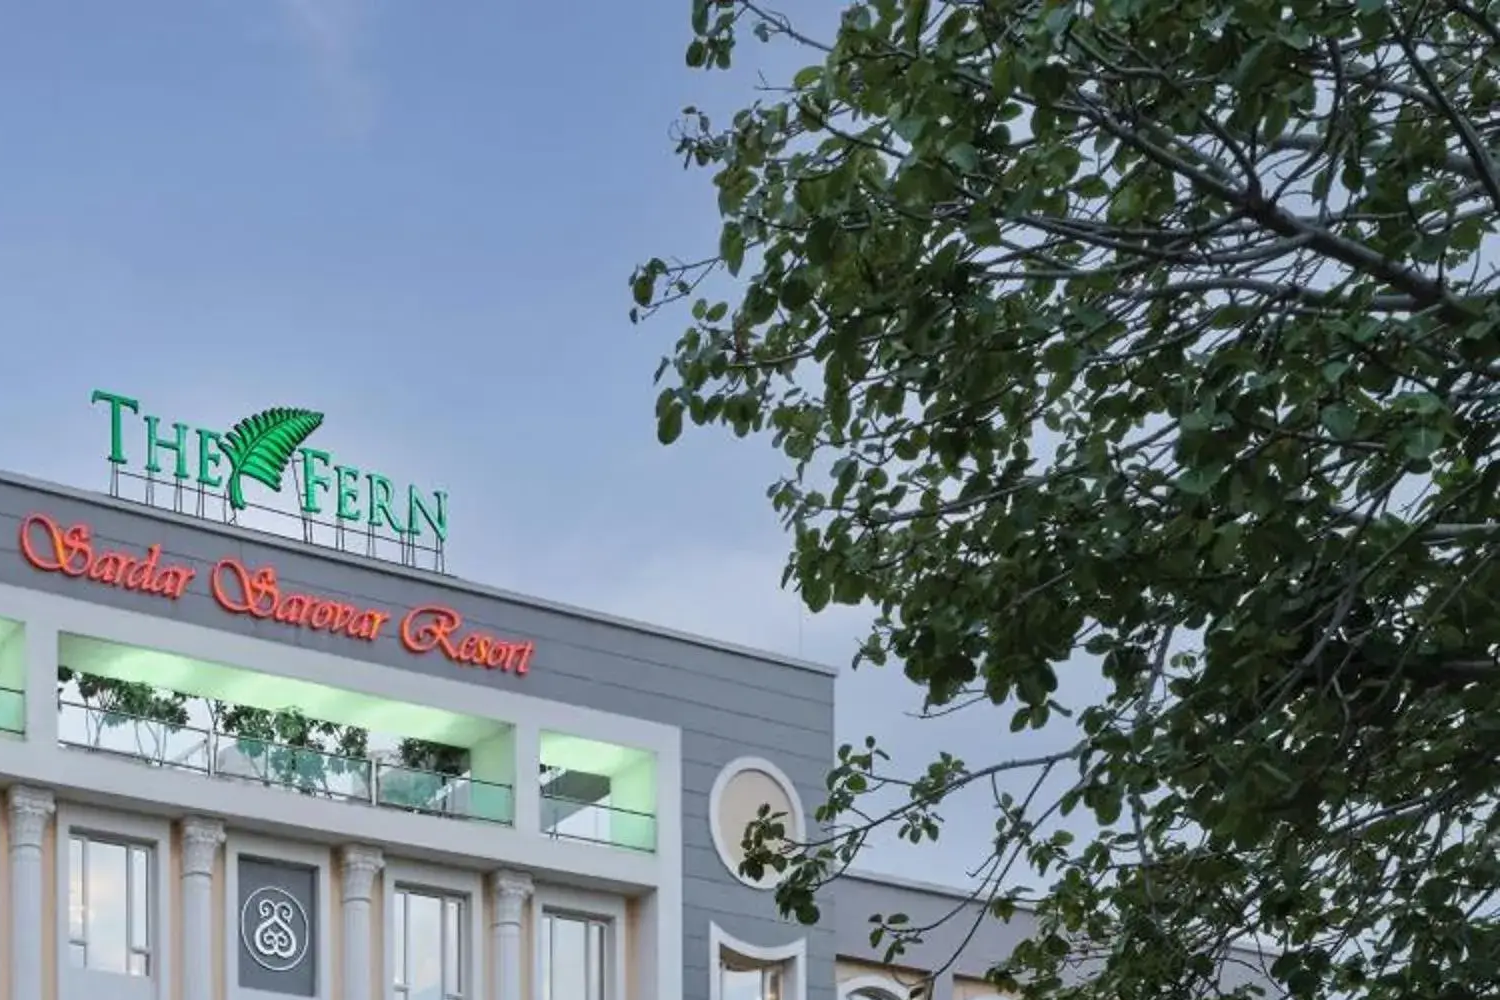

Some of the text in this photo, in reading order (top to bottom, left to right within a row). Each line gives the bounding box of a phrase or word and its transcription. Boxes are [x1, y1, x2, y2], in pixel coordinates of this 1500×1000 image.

[91, 390, 448, 542] THE FERN
[20, 513, 535, 676] Sardar Sarovar Resort
